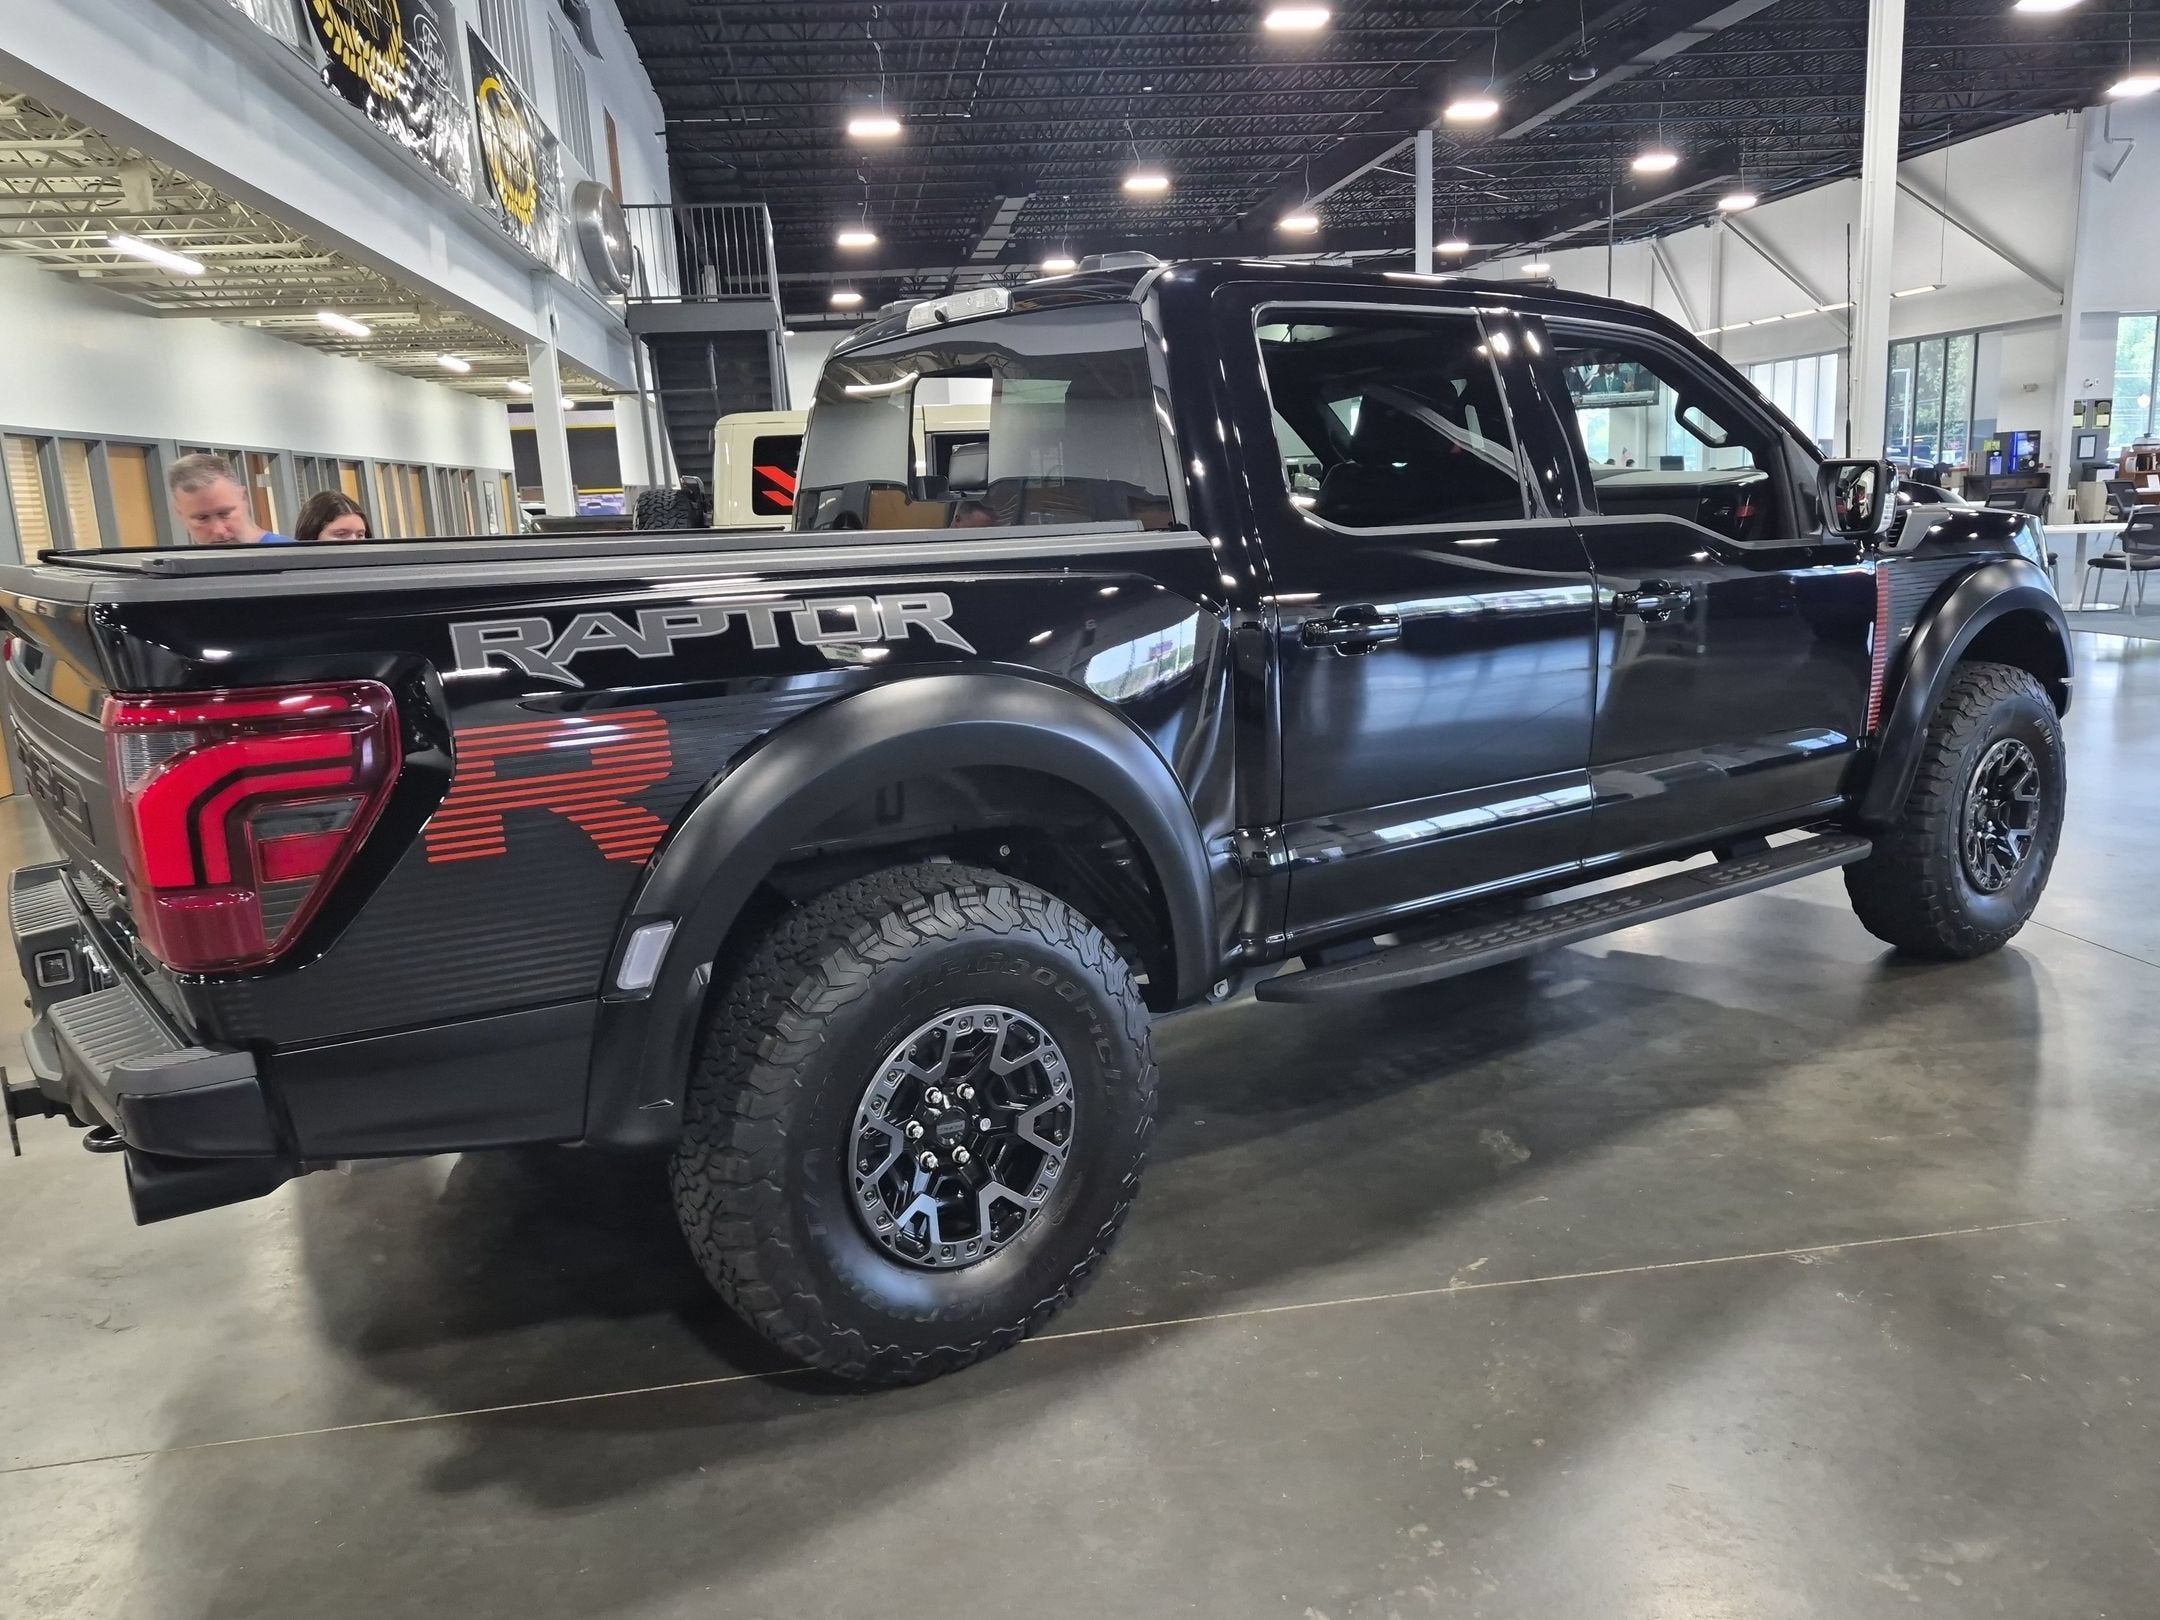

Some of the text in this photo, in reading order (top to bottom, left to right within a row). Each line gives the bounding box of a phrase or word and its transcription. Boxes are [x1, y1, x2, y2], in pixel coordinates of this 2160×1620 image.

[419, 22, 447, 80] Ford
[448, 592, 977, 688] RAPTOR
[423, 709, 673, 864] R
